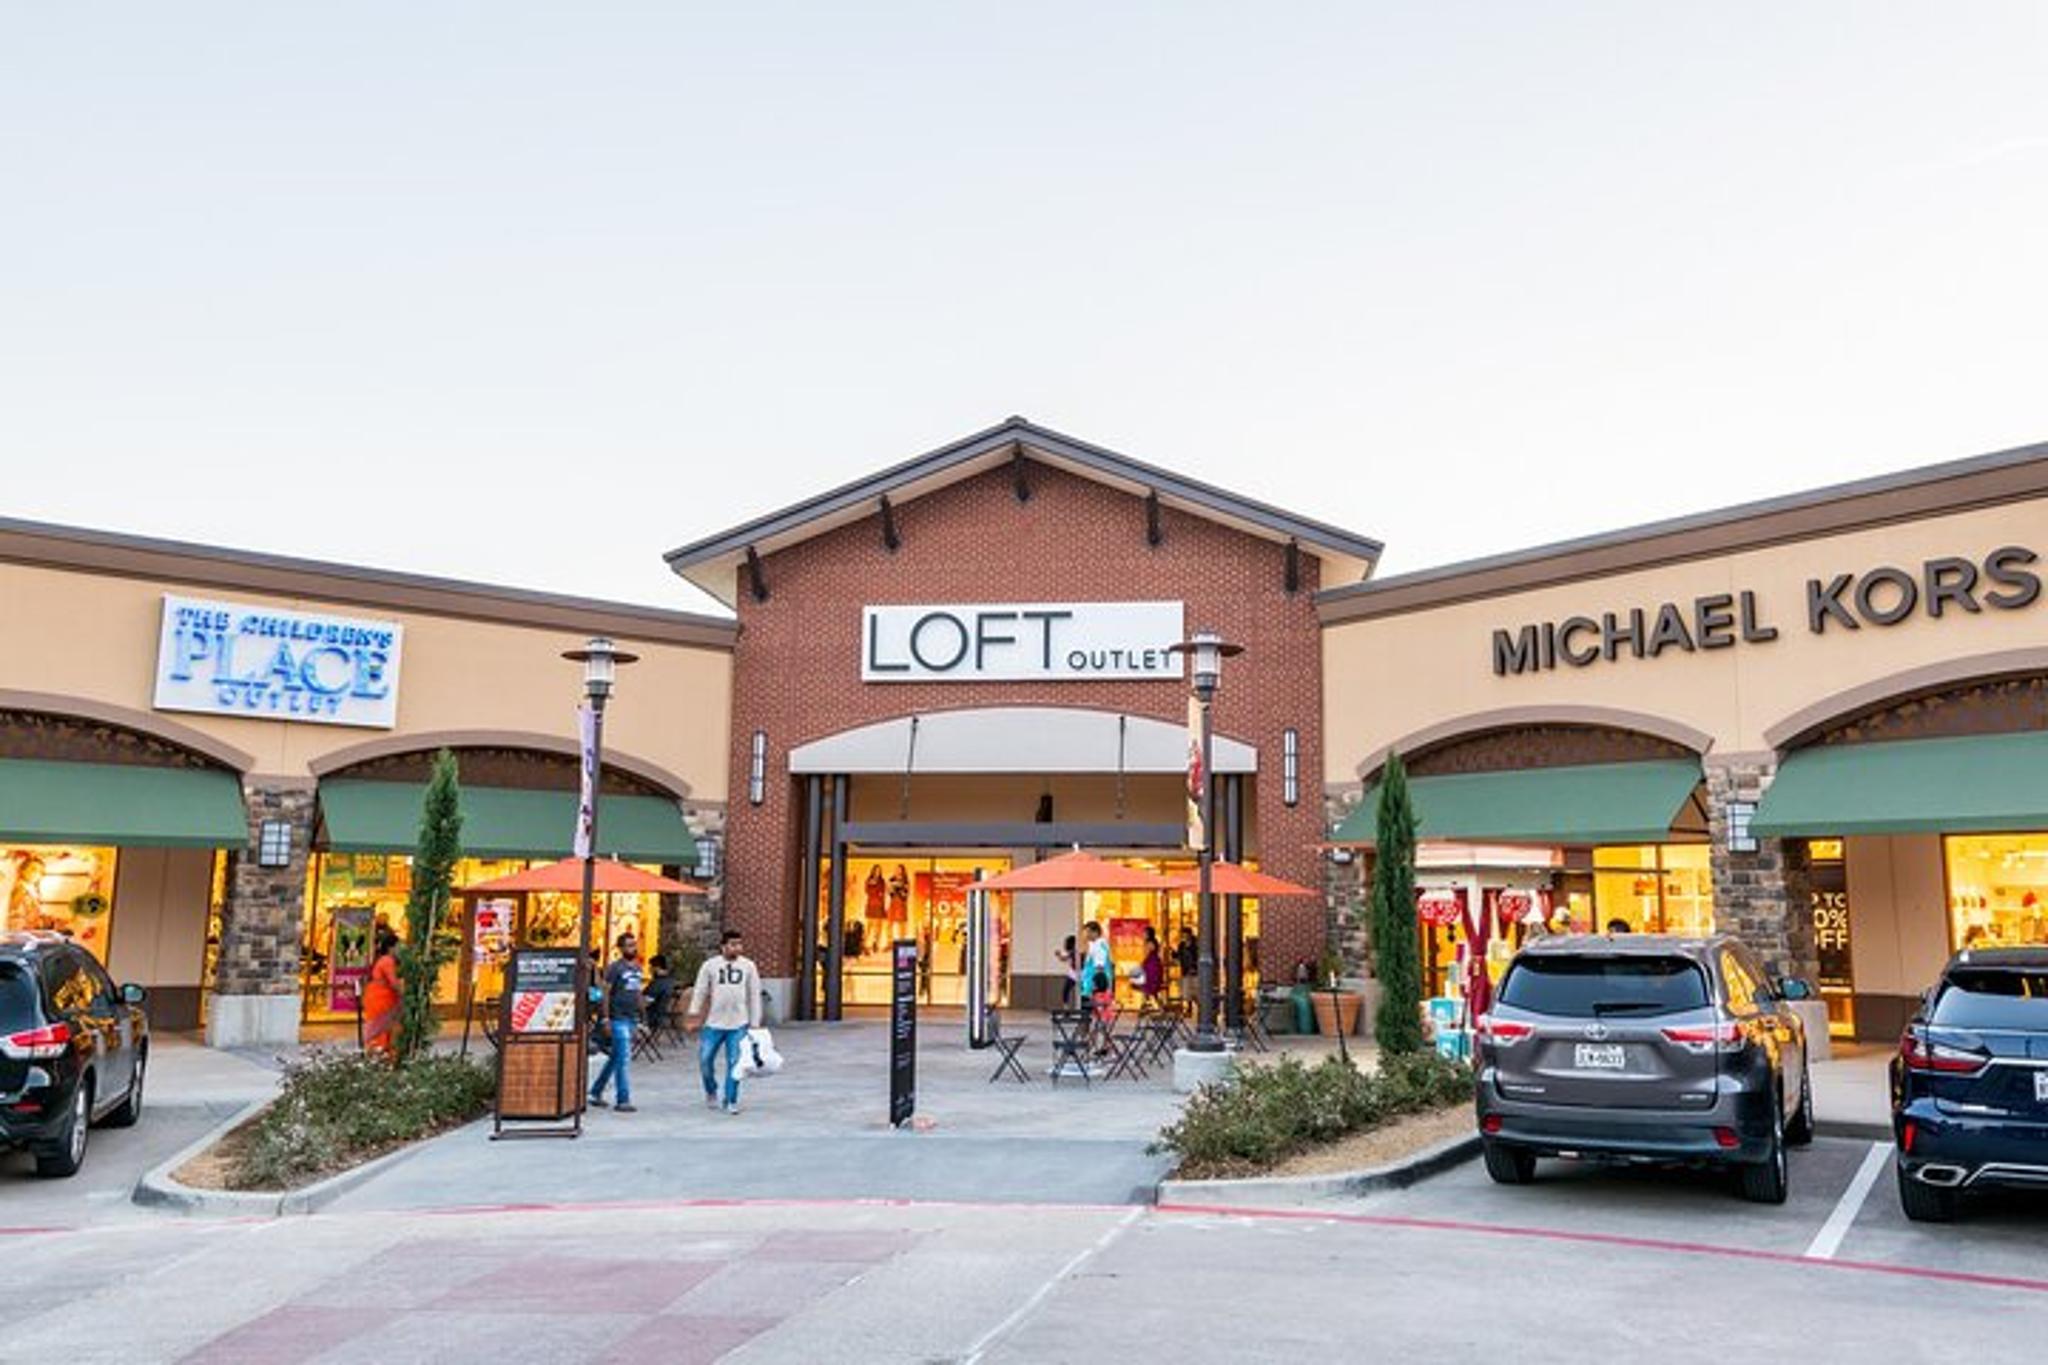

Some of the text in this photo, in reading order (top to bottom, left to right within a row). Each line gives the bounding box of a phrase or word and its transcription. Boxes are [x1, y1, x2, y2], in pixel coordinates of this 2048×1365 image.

[176, 607, 230, 631] THE
[1492, 546, 2043, 675] MICHAEL KORS
[869, 611, 1172, 672] LOFT OUTLET
[170, 630, 389, 700] PLACE
[218, 688, 341, 714] OUTLET
[1814, 909, 1847, 928] 0%
